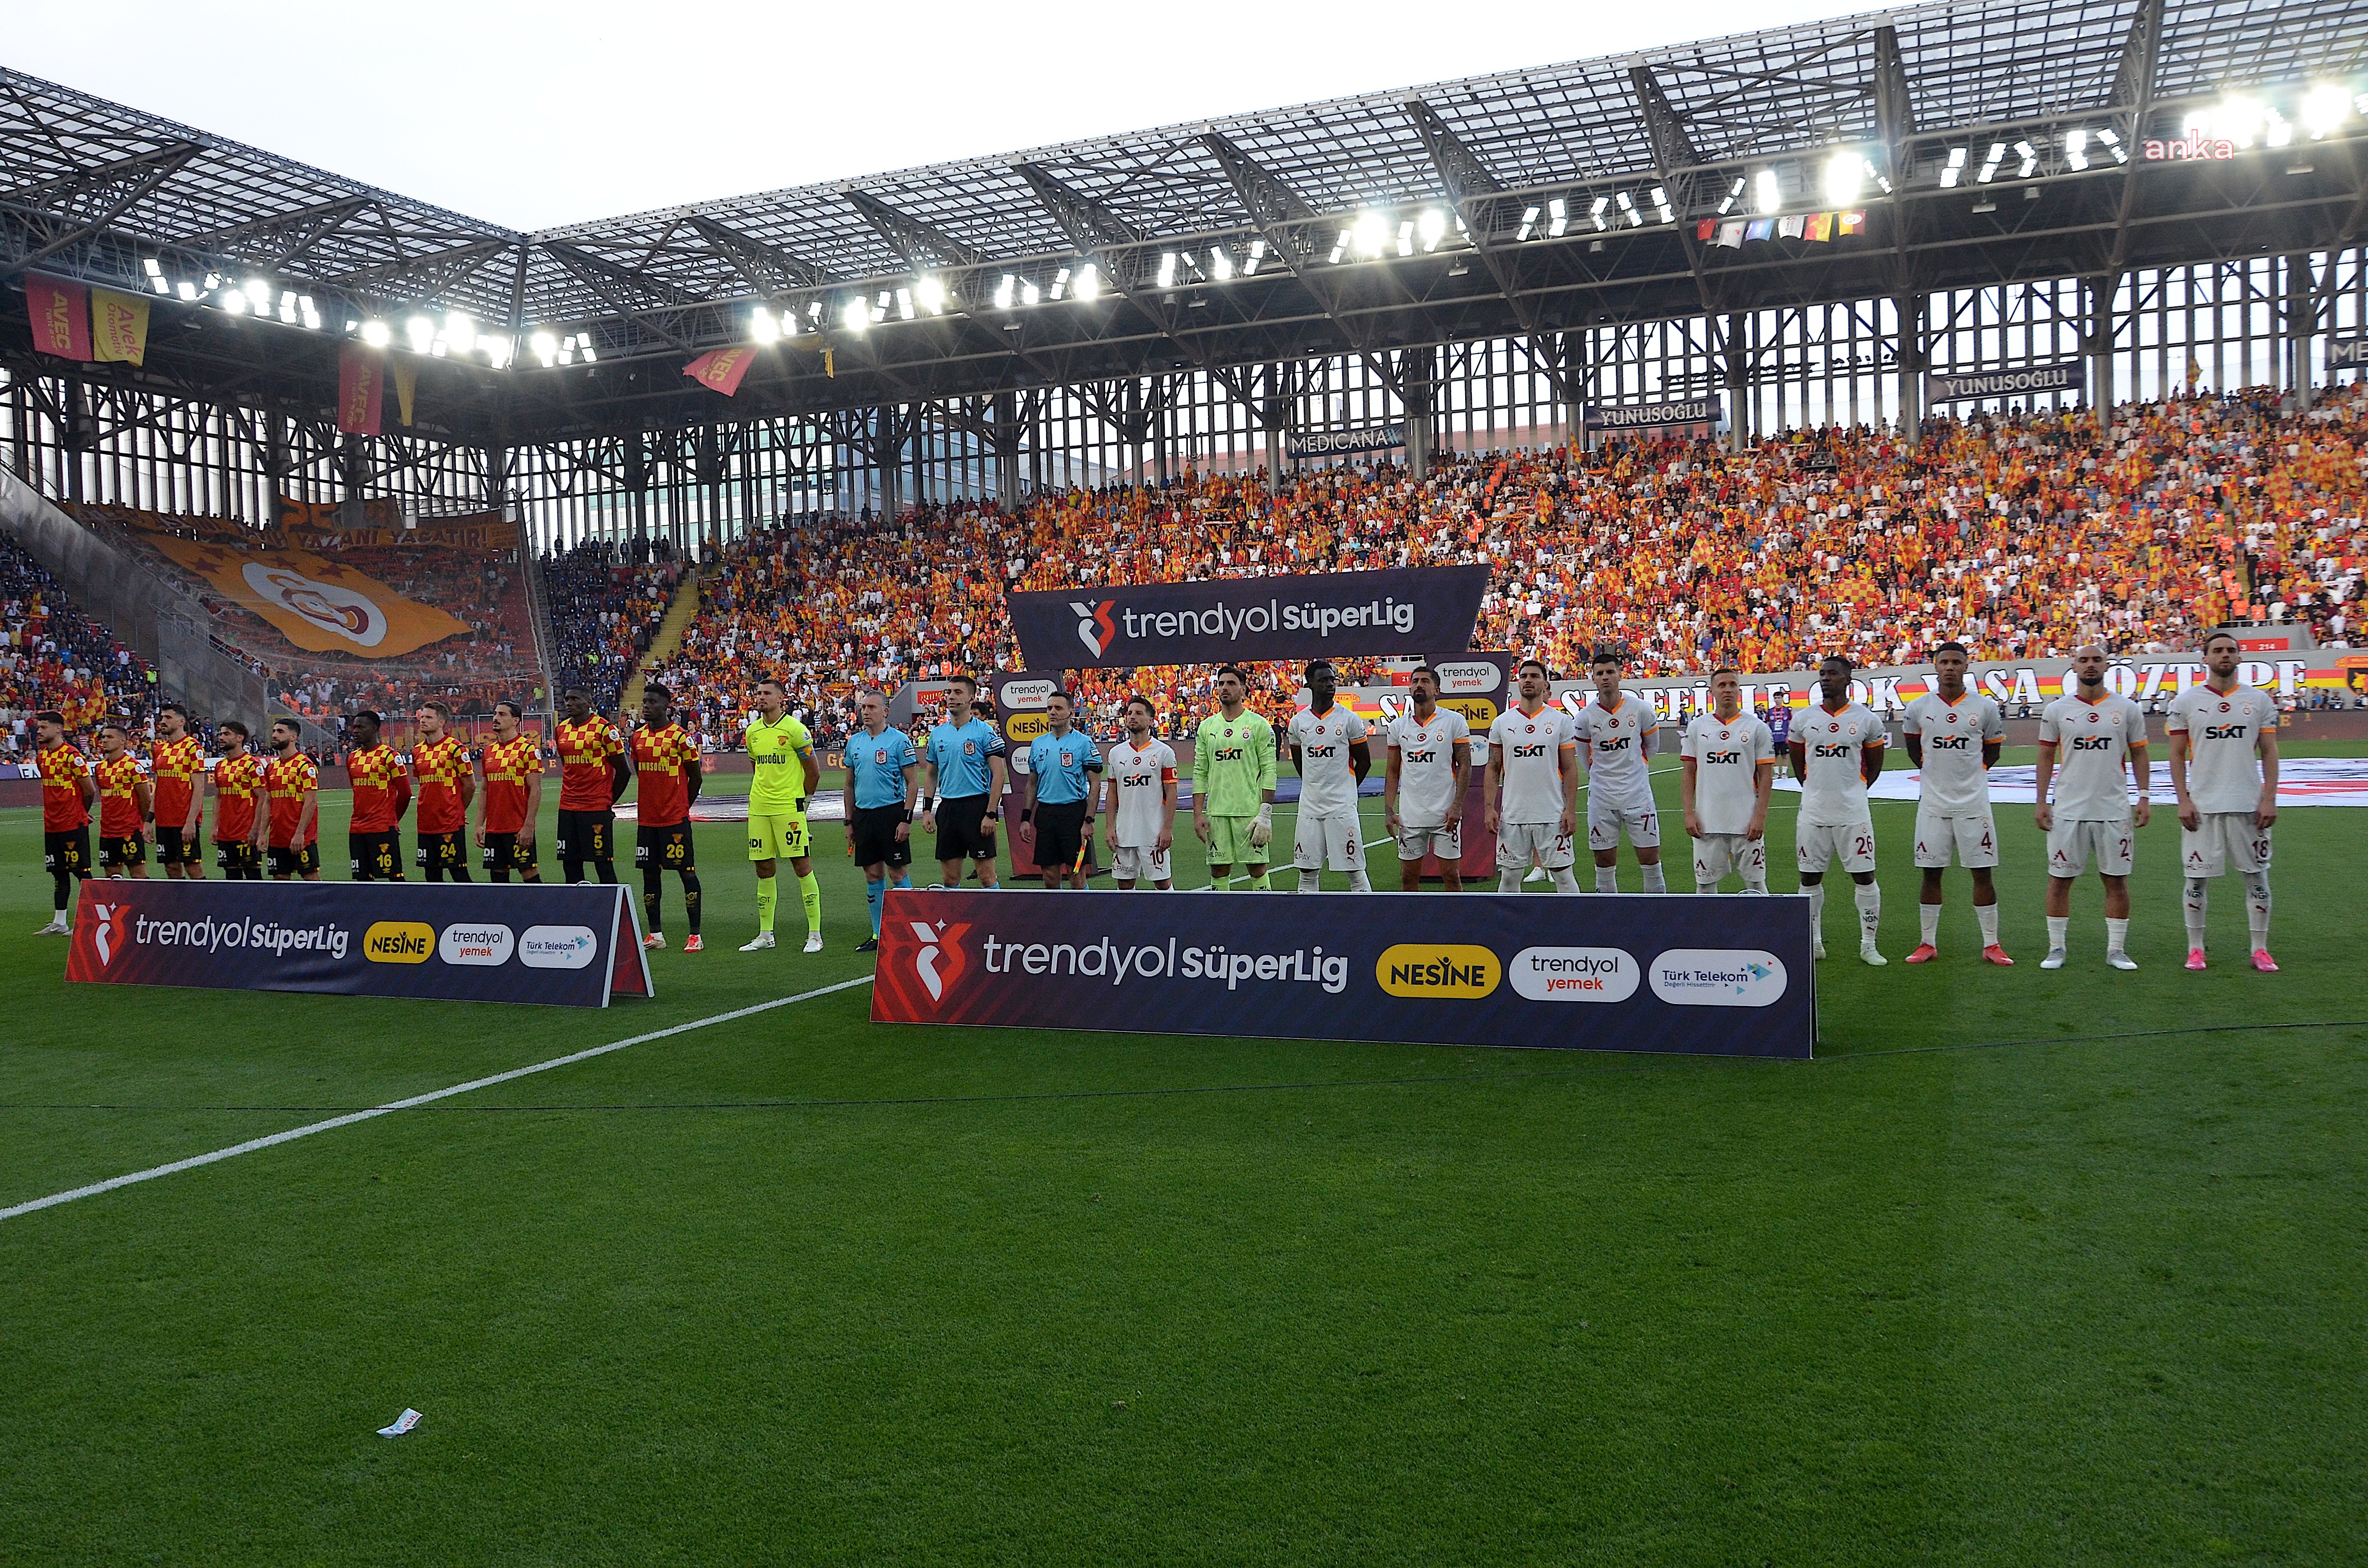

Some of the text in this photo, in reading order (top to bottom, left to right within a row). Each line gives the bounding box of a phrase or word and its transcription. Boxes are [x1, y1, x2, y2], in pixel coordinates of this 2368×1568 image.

[53, 290, 72, 350] AVEC
[118, 306, 142, 358] Avek
[1291, 429, 1388, 454] MEDICANA
[1122, 599, 1278, 640] trendyol
[1443, 667, 1490, 678] trendyol
[1011, 685, 1048, 695] trendyol
[1452, 679, 1482, 688] yemek
[1018, 696, 1042, 704] yemek
[1641, 813, 1656, 831] 77
[556, 840, 566, 849] DI
[594, 835, 603, 849] 5
[786, 830, 802, 845] 97
[1555, 834, 1571, 852] 23
[1855, 835, 1873, 855] 26
[1981, 832, 1992, 849] 4
[123, 842, 137, 855] 43
[236, 843, 250, 857] 77
[440, 843, 456, 858] 24
[513, 845, 530, 858] 22
[666, 844, 684, 858] 26
[1346, 840, 1355, 855] 6
[2252, 840, 2269, 858] 18
[64, 851, 79, 862] 79
[301, 851, 309, 863] 8
[377, 854, 392, 868] 16
[1150, 849, 1164, 865] 10
[136, 914, 251, 954] trendyol
[453, 930, 504, 946] trendyol
[459, 947, 493, 958] yemek
[527, 941, 575, 950] Türk Telekom
[983, 934, 1175, 985] trendyol
[1531, 955, 1619, 976] trendyol
[1662, 970, 1748, 982] Türk Telekom
[1547, 976, 1603, 992] yemek
